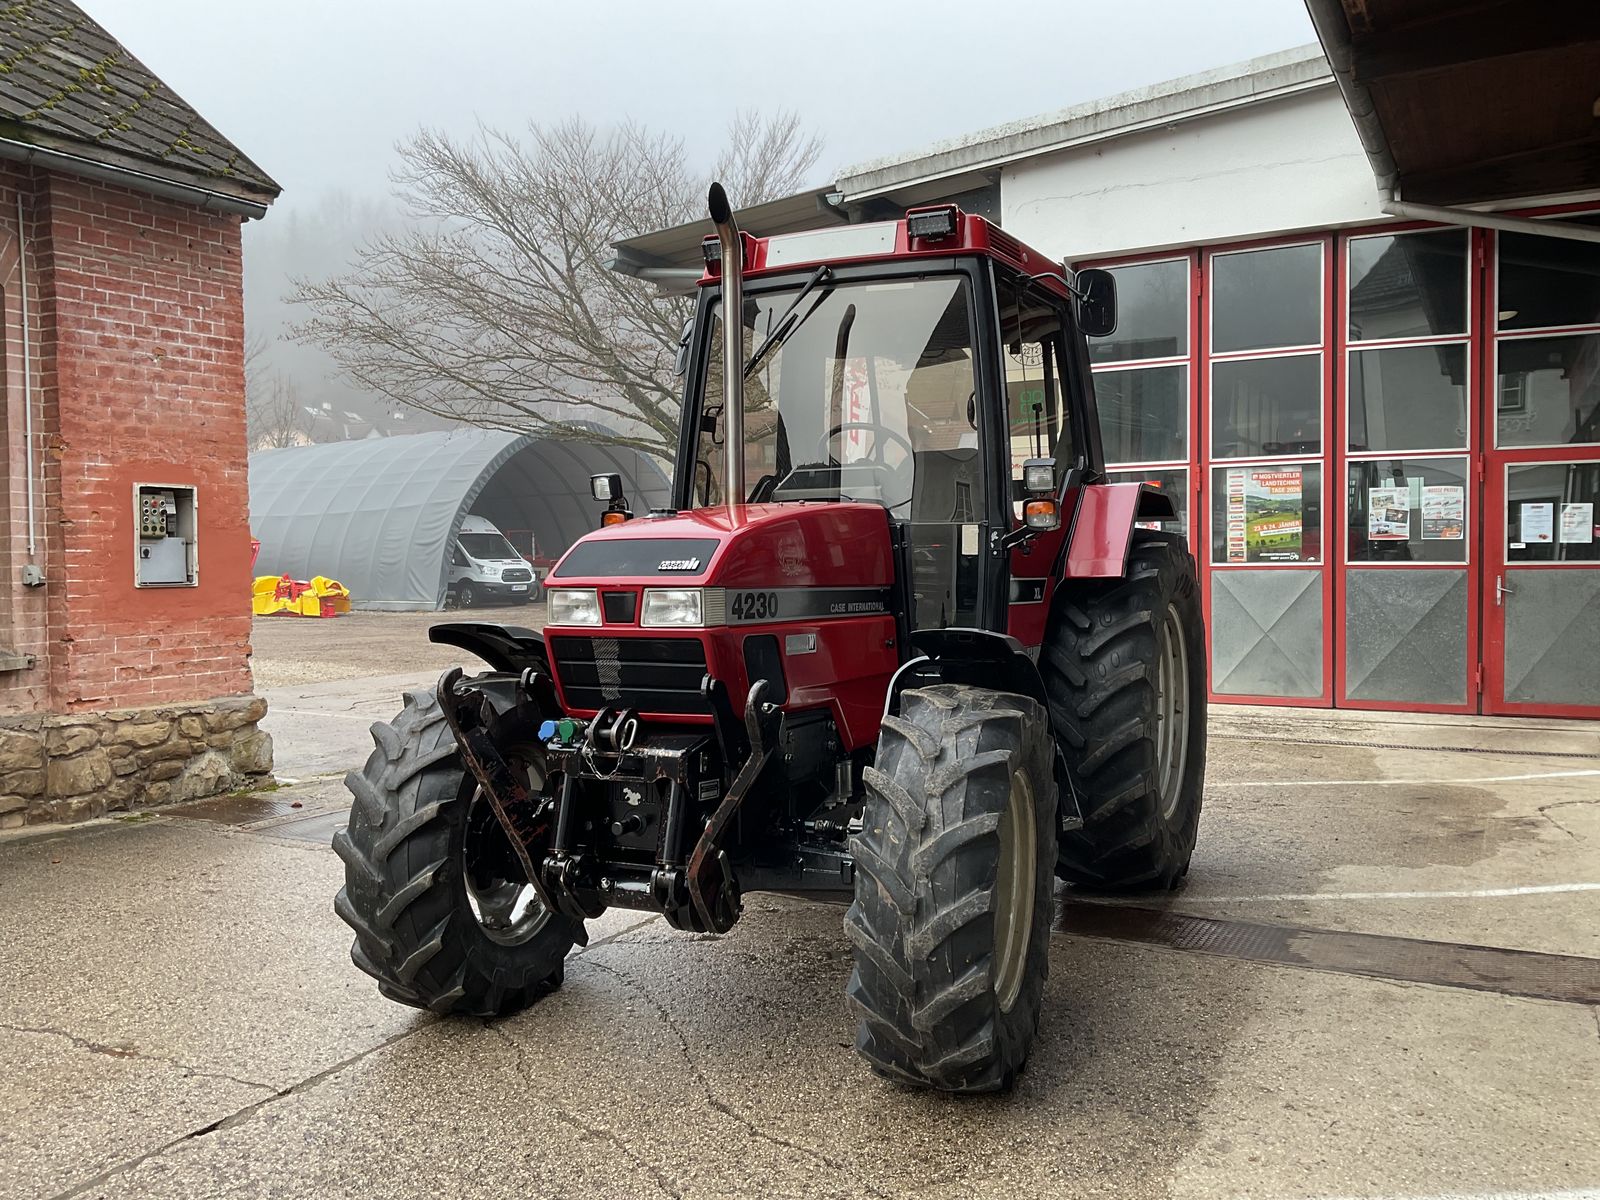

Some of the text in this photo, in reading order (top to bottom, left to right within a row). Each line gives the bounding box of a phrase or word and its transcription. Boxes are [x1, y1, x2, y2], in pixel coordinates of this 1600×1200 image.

[731, 592, 778, 620] 4230
[830, 602, 885, 613] CASE INTERNATIONAL
